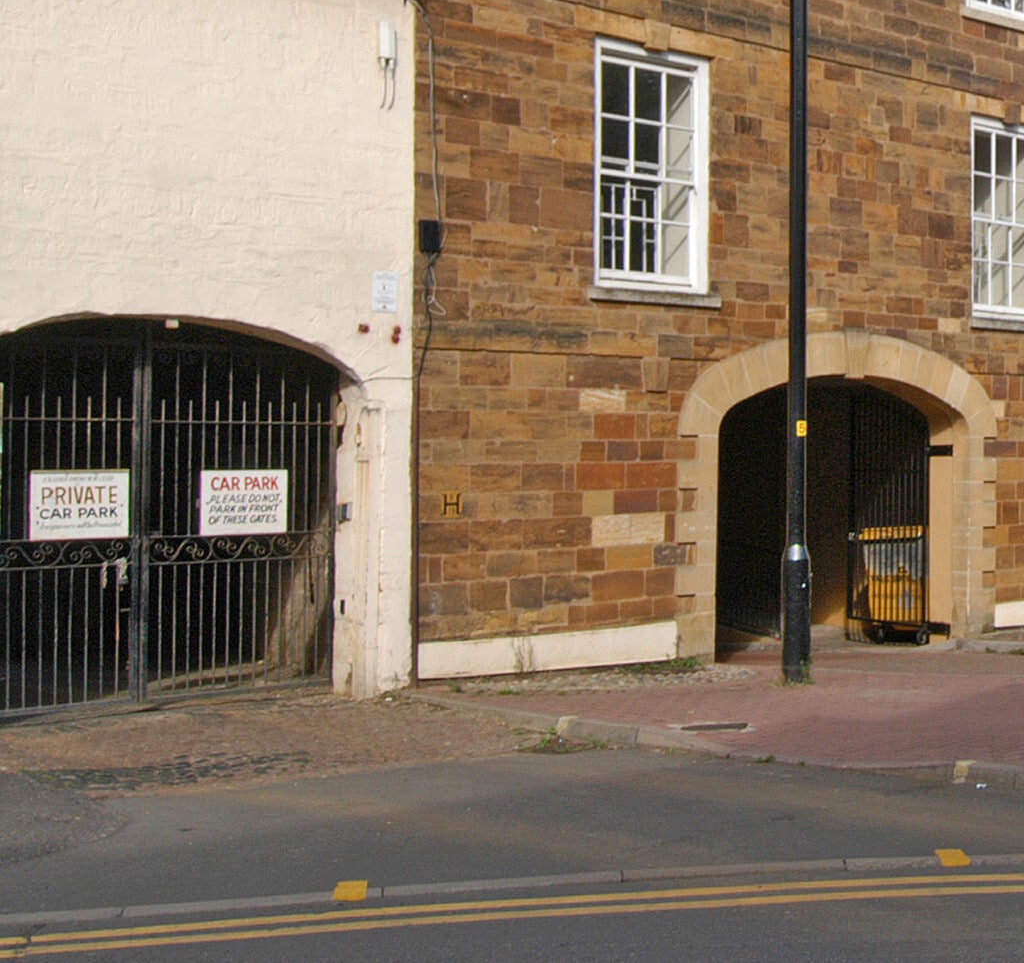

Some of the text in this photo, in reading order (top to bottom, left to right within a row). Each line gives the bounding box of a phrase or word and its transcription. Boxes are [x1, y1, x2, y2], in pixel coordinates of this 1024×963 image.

[210, 476, 279, 491] CAR PARK
[41, 486, 118, 505] PRIVATE
[208, 493, 280, 504] PLEASE DO NOT
[208, 504, 279, 513] PARK IN FRONT
[443, 493, 461, 515] H
[39, 507, 119, 520] CAR PARK
[208, 516, 223, 525] OF
[222, 515, 248, 524] THESE
